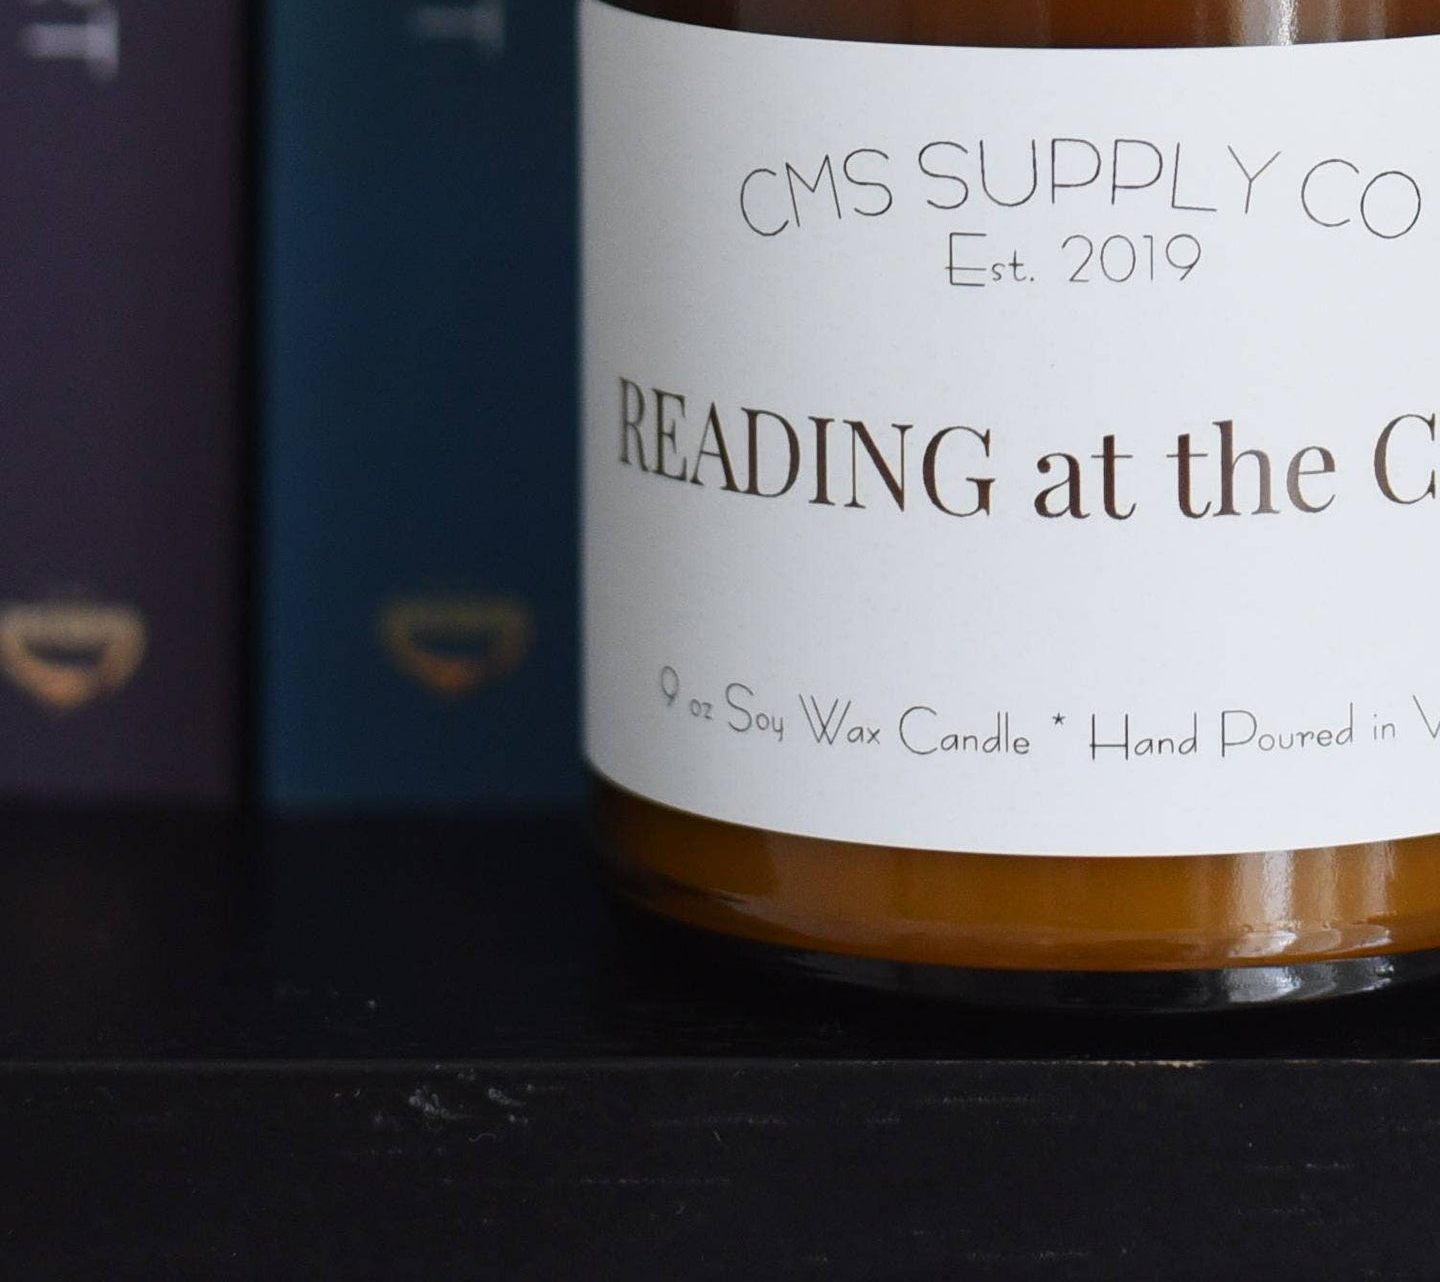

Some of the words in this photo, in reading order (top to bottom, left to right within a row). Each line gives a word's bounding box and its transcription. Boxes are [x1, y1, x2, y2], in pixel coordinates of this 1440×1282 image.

[738, 147, 894, 238] CMS
[916, 136, 1282, 215] SUPPLY
[1299, 157, 1423, 241] CO
[944, 230, 1036, 289] Est.
[1060, 232, 1203, 284] 2019
[618, 376, 997, 519] READING
[1033, 433, 1137, 522] at
[1166, 418, 1337, 521] the
[659, 664, 680, 708] 9
[688, 698, 713, 721] oz
[724, 681, 785, 743] Soy
[797, 693, 881, 747] Wax
[897, 704, 1031, 757] Candle
[1088, 711, 1198, 762] Hand
[1220, 701, 1354, 759] Poured
[1370, 714, 1398, 742] in
